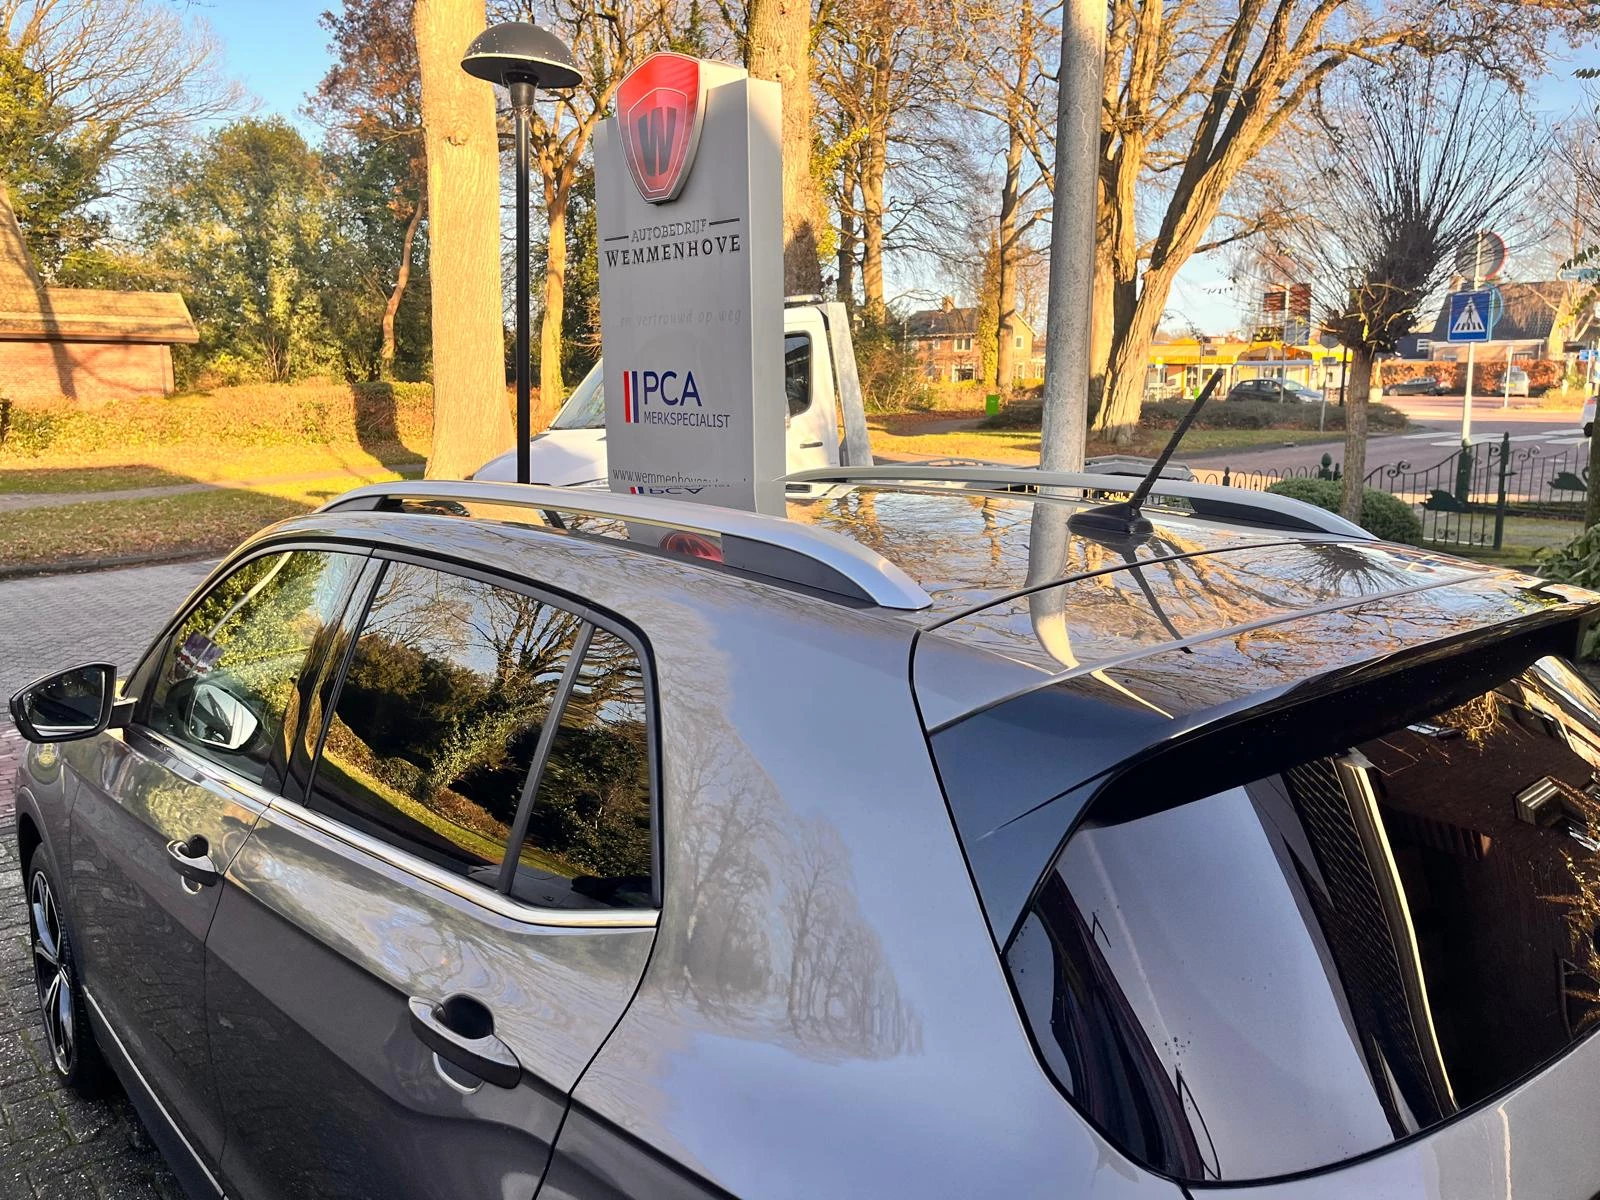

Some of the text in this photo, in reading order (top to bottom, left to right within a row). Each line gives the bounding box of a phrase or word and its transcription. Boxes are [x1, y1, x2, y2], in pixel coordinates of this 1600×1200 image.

[638, 107, 677, 177] W
[631, 218, 707, 243] AUTOBEDRIJF
[604, 234, 741, 268] WEMMENHOVE
[636, 309, 694, 327] vertrouwd
[698, 311, 713, 326] op
[718, 308, 743, 324] weg
[643, 370, 703, 407] PCA
[643, 411, 731, 428] MERKSPECIALIST
